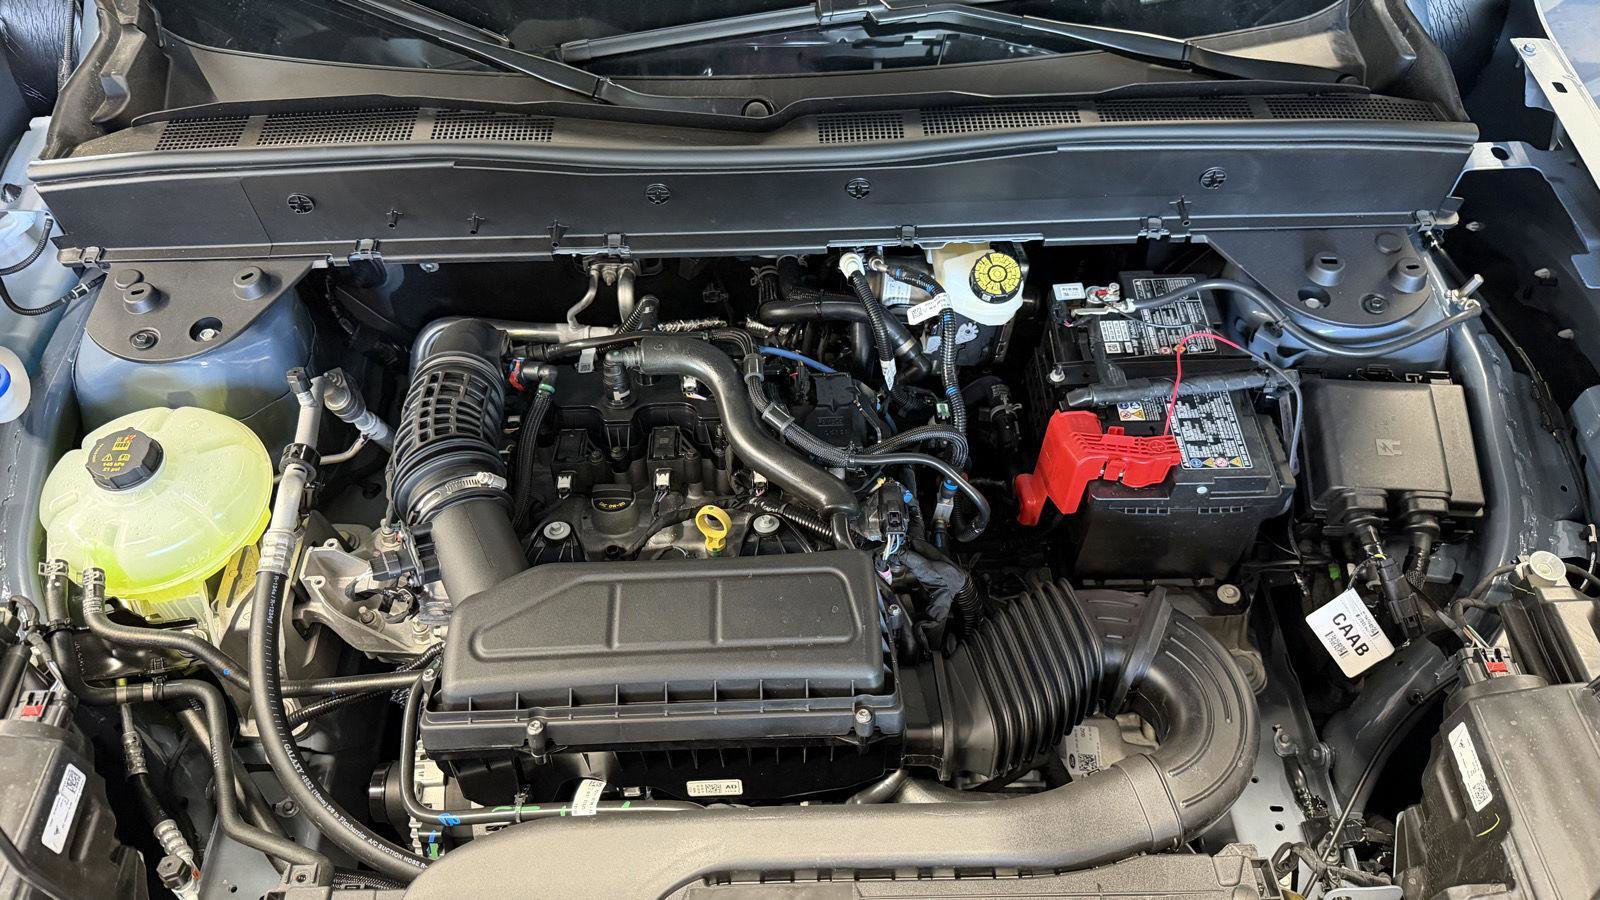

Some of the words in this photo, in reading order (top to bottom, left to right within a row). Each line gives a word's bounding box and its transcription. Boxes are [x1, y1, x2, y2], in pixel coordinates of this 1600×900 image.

[1332, 612, 1370, 657] CAAB
[284, 743, 304, 773] GALAXY
[367, 838, 378, 847] A/C
[377, 844, 403, 859] SUCTION
[403, 856, 420, 868] HOSE
